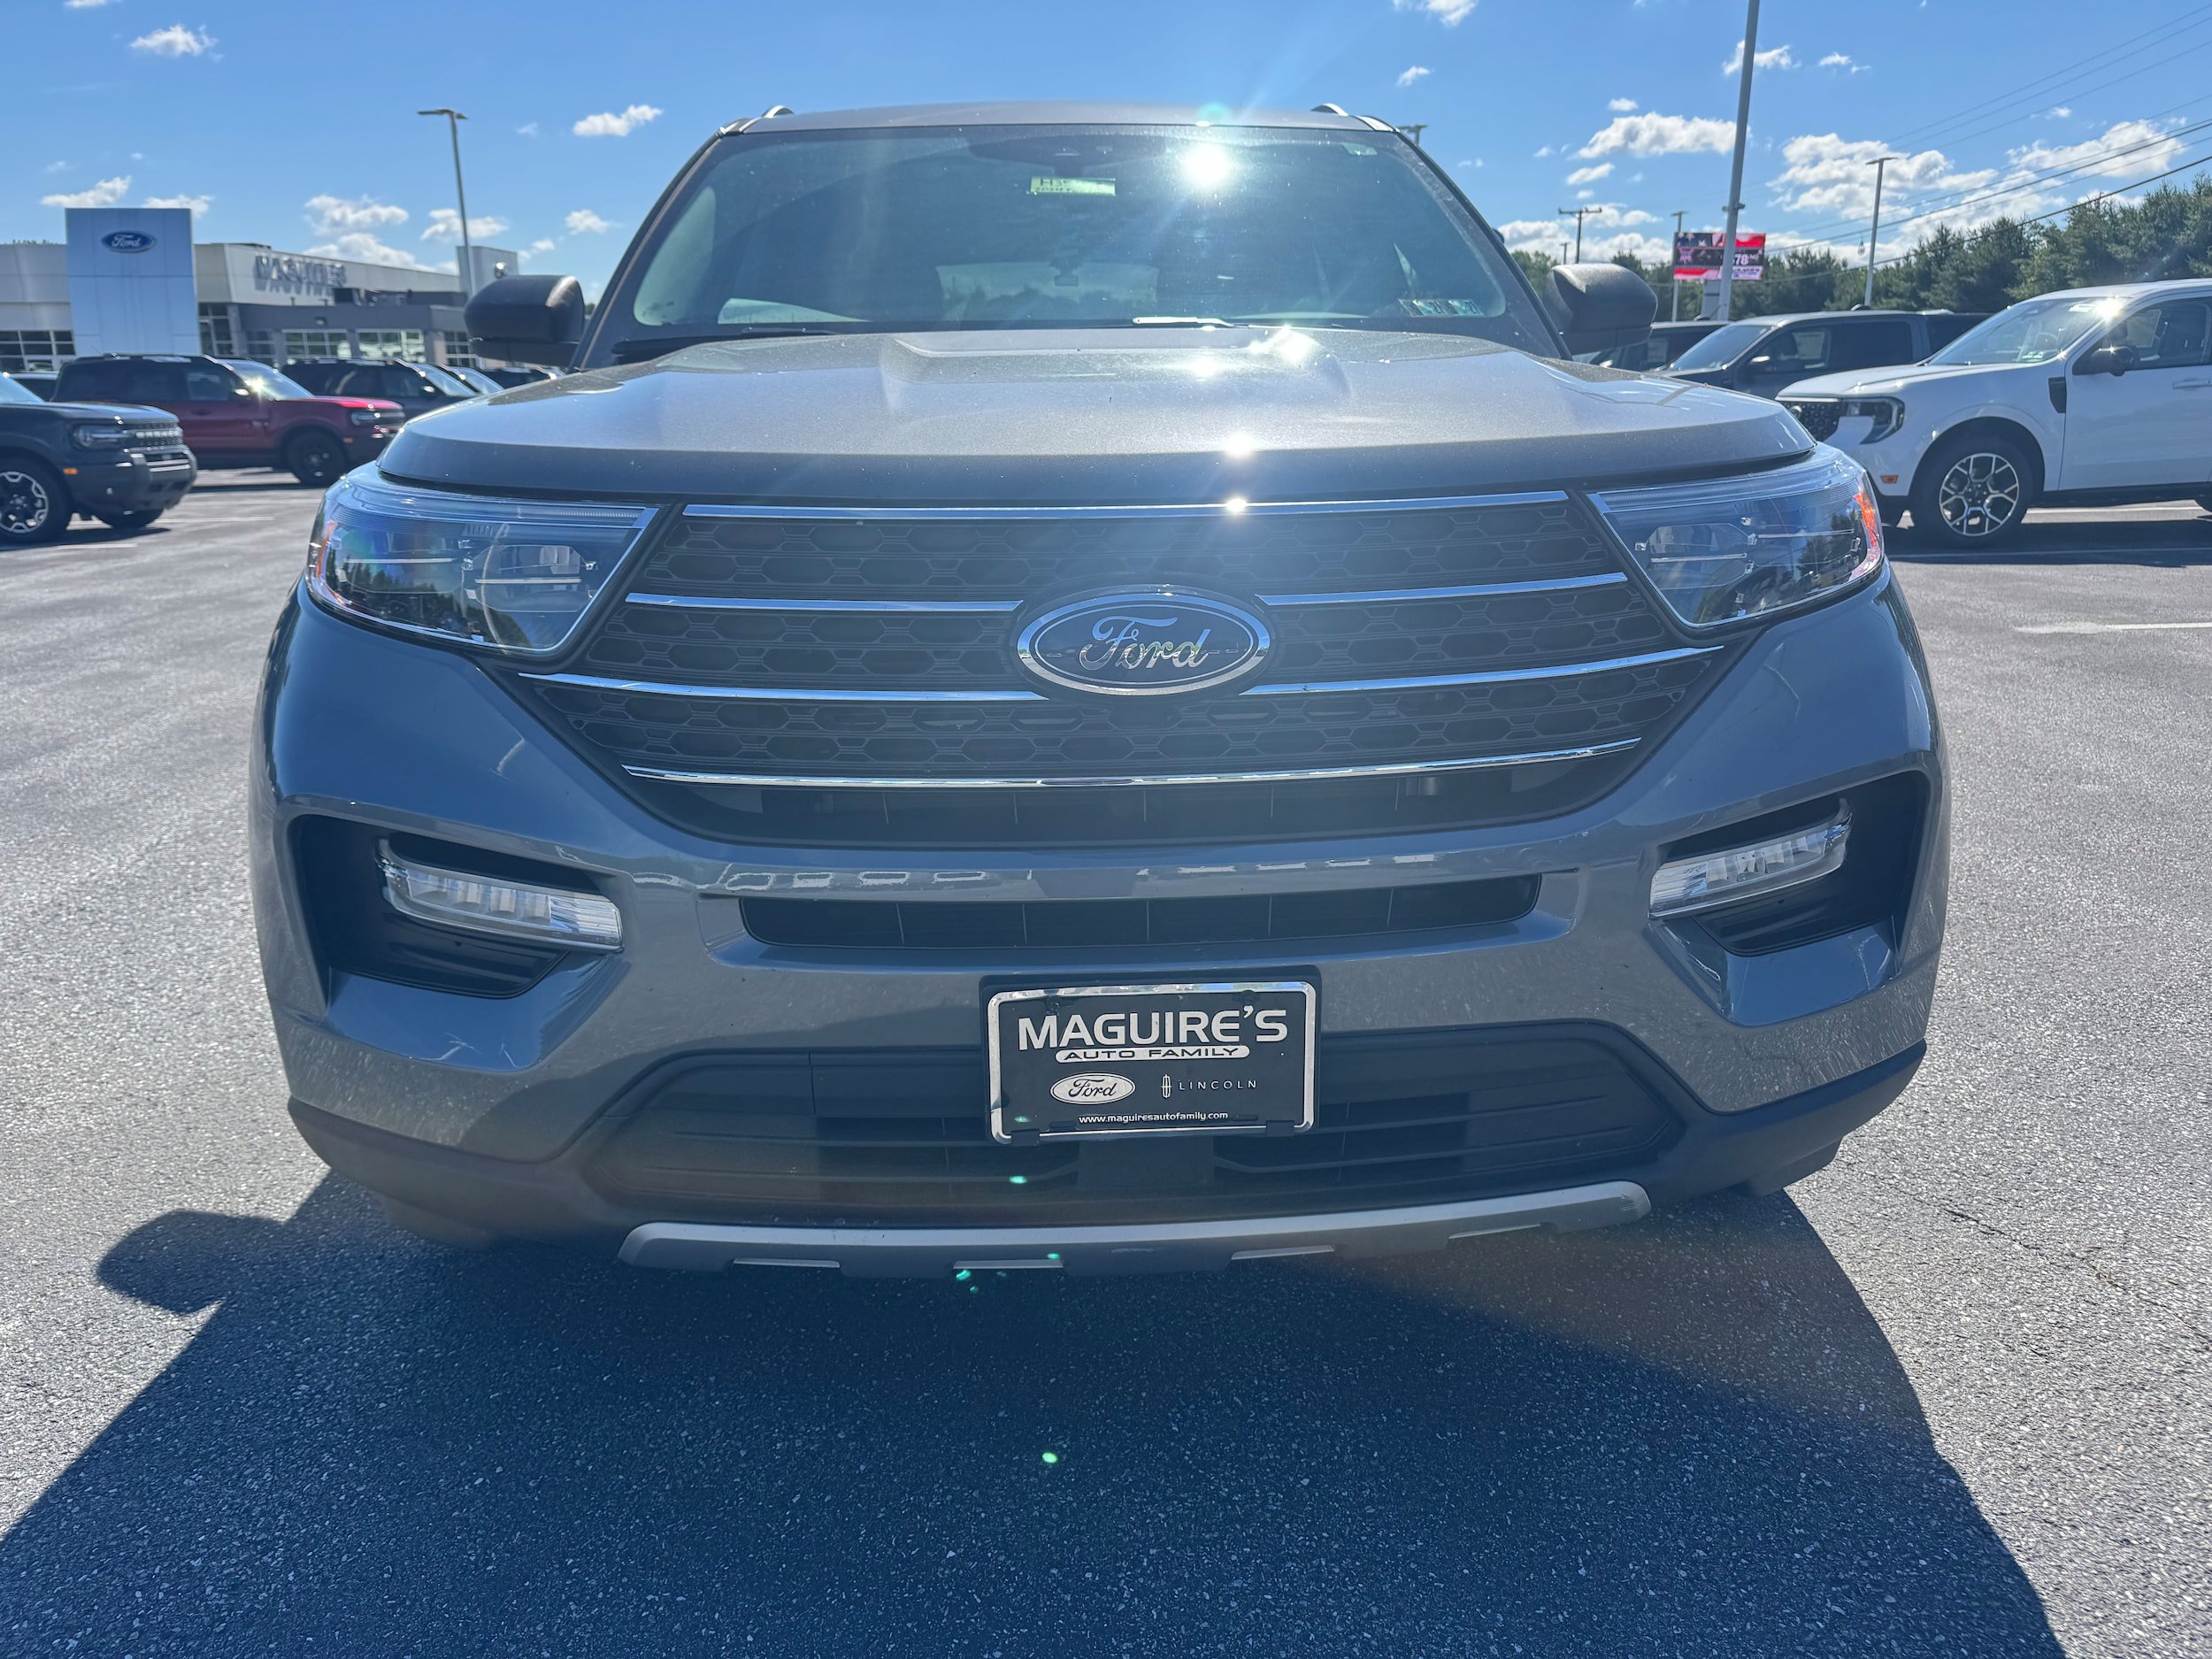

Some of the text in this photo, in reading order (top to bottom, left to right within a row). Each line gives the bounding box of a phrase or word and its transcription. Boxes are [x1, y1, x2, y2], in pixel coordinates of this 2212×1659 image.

[111, 234, 142, 248] Ford
[1079, 615, 1211, 670] Ford
[1018, 1005, 1288, 1051] MAGUIRE'S
[1064, 1048, 1239, 1061] AUTO FAMILY
[1068, 1079, 1257, 1098] Ford LINCOLN
[1079, 1111, 1229, 1125] www.maguiresautofamily.com
